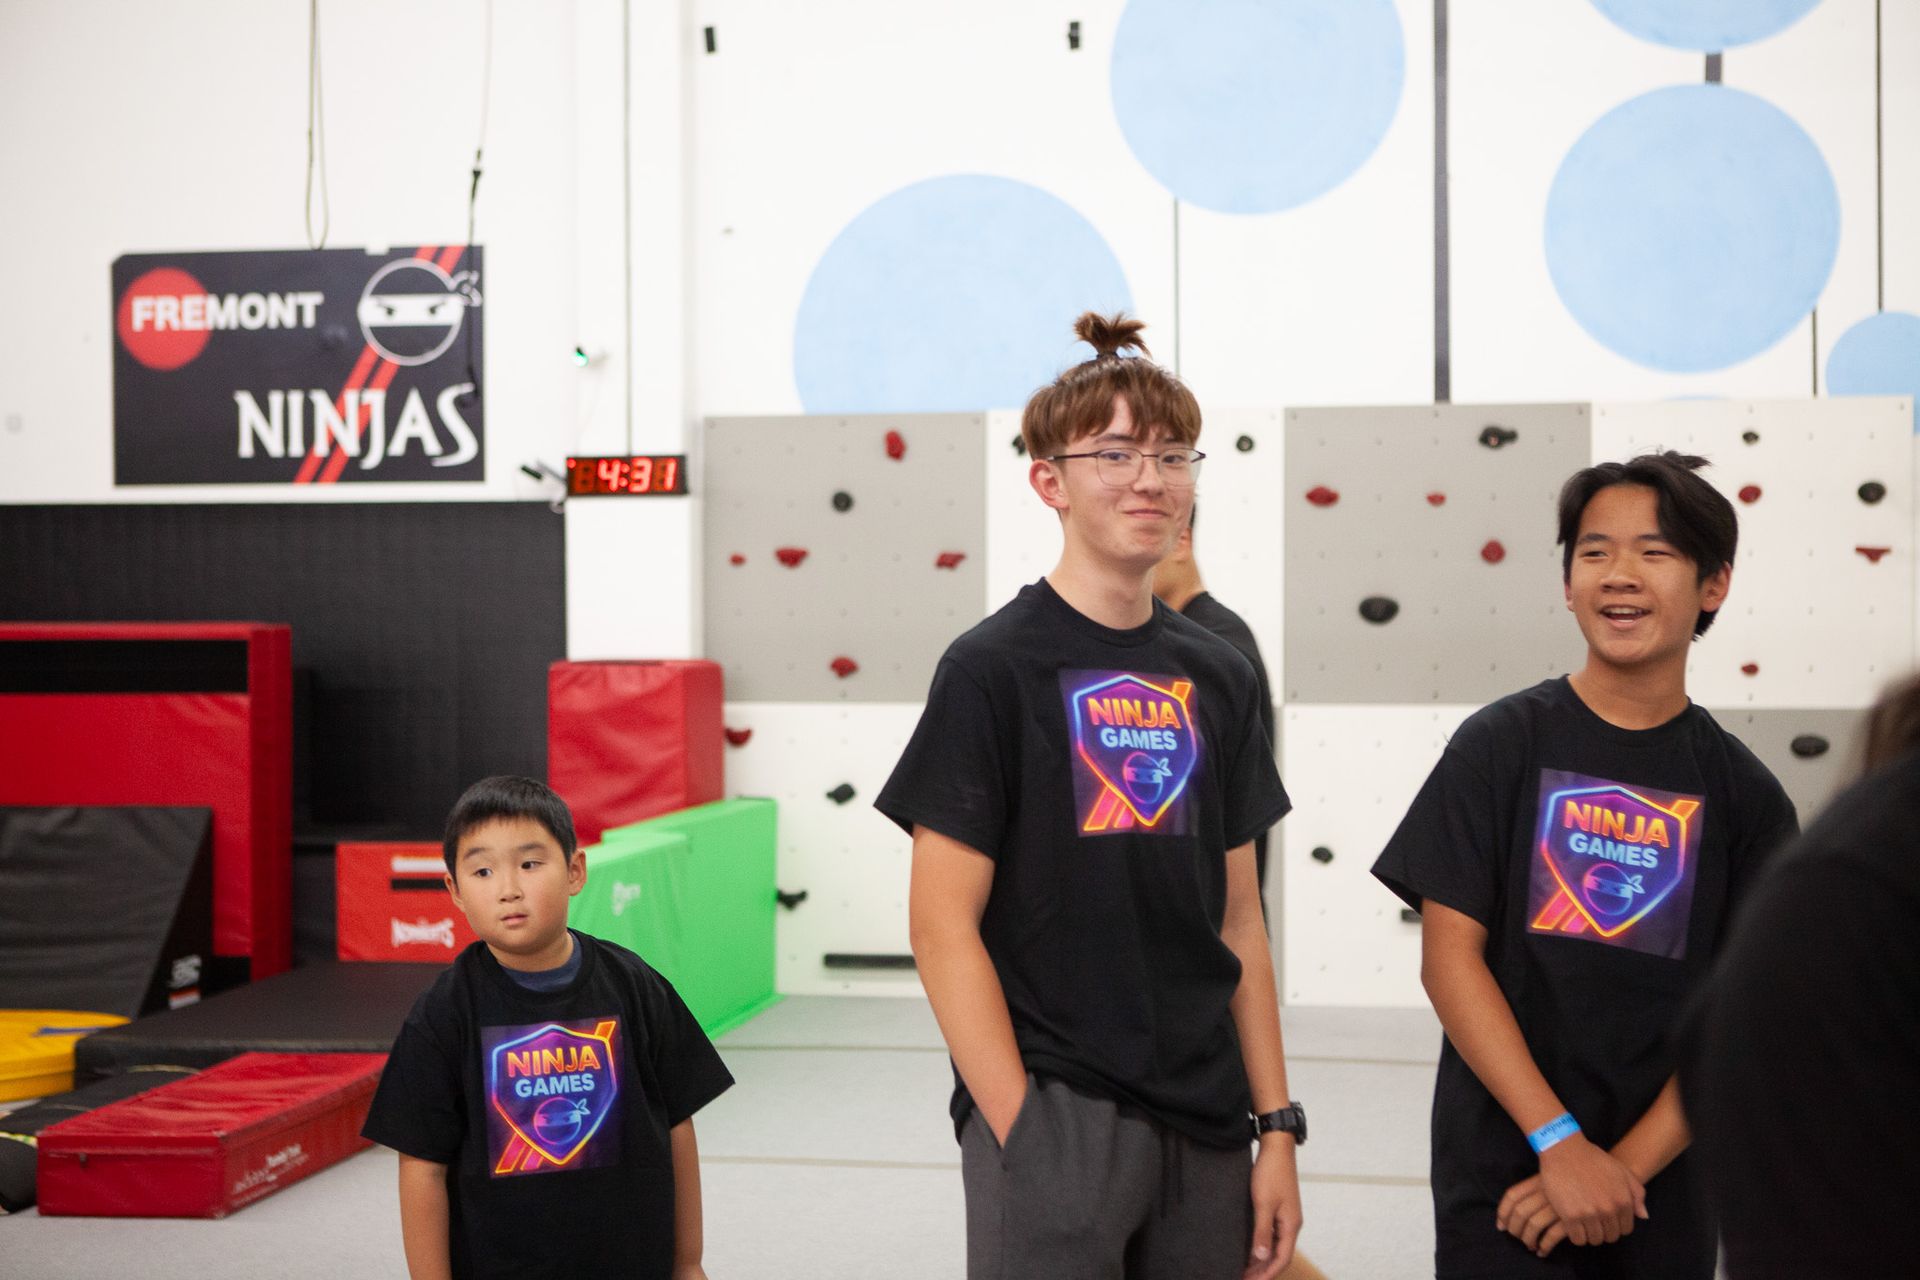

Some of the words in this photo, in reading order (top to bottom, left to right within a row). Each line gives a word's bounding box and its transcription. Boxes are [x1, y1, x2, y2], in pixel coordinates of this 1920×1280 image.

[131, 291, 325, 332] FREMONT
[233, 382, 479, 470] NINJAS
[597, 456, 677, 493] 4:31
[1087, 697, 1182, 729] NINJA
[1100, 727, 1177, 751] GAMES
[1563, 799, 1670, 848] NINJA
[1568, 832, 1659, 869] GAMES
[507, 1045, 601, 1078] NINJA
[514, 1072, 595, 1098] GAMES
